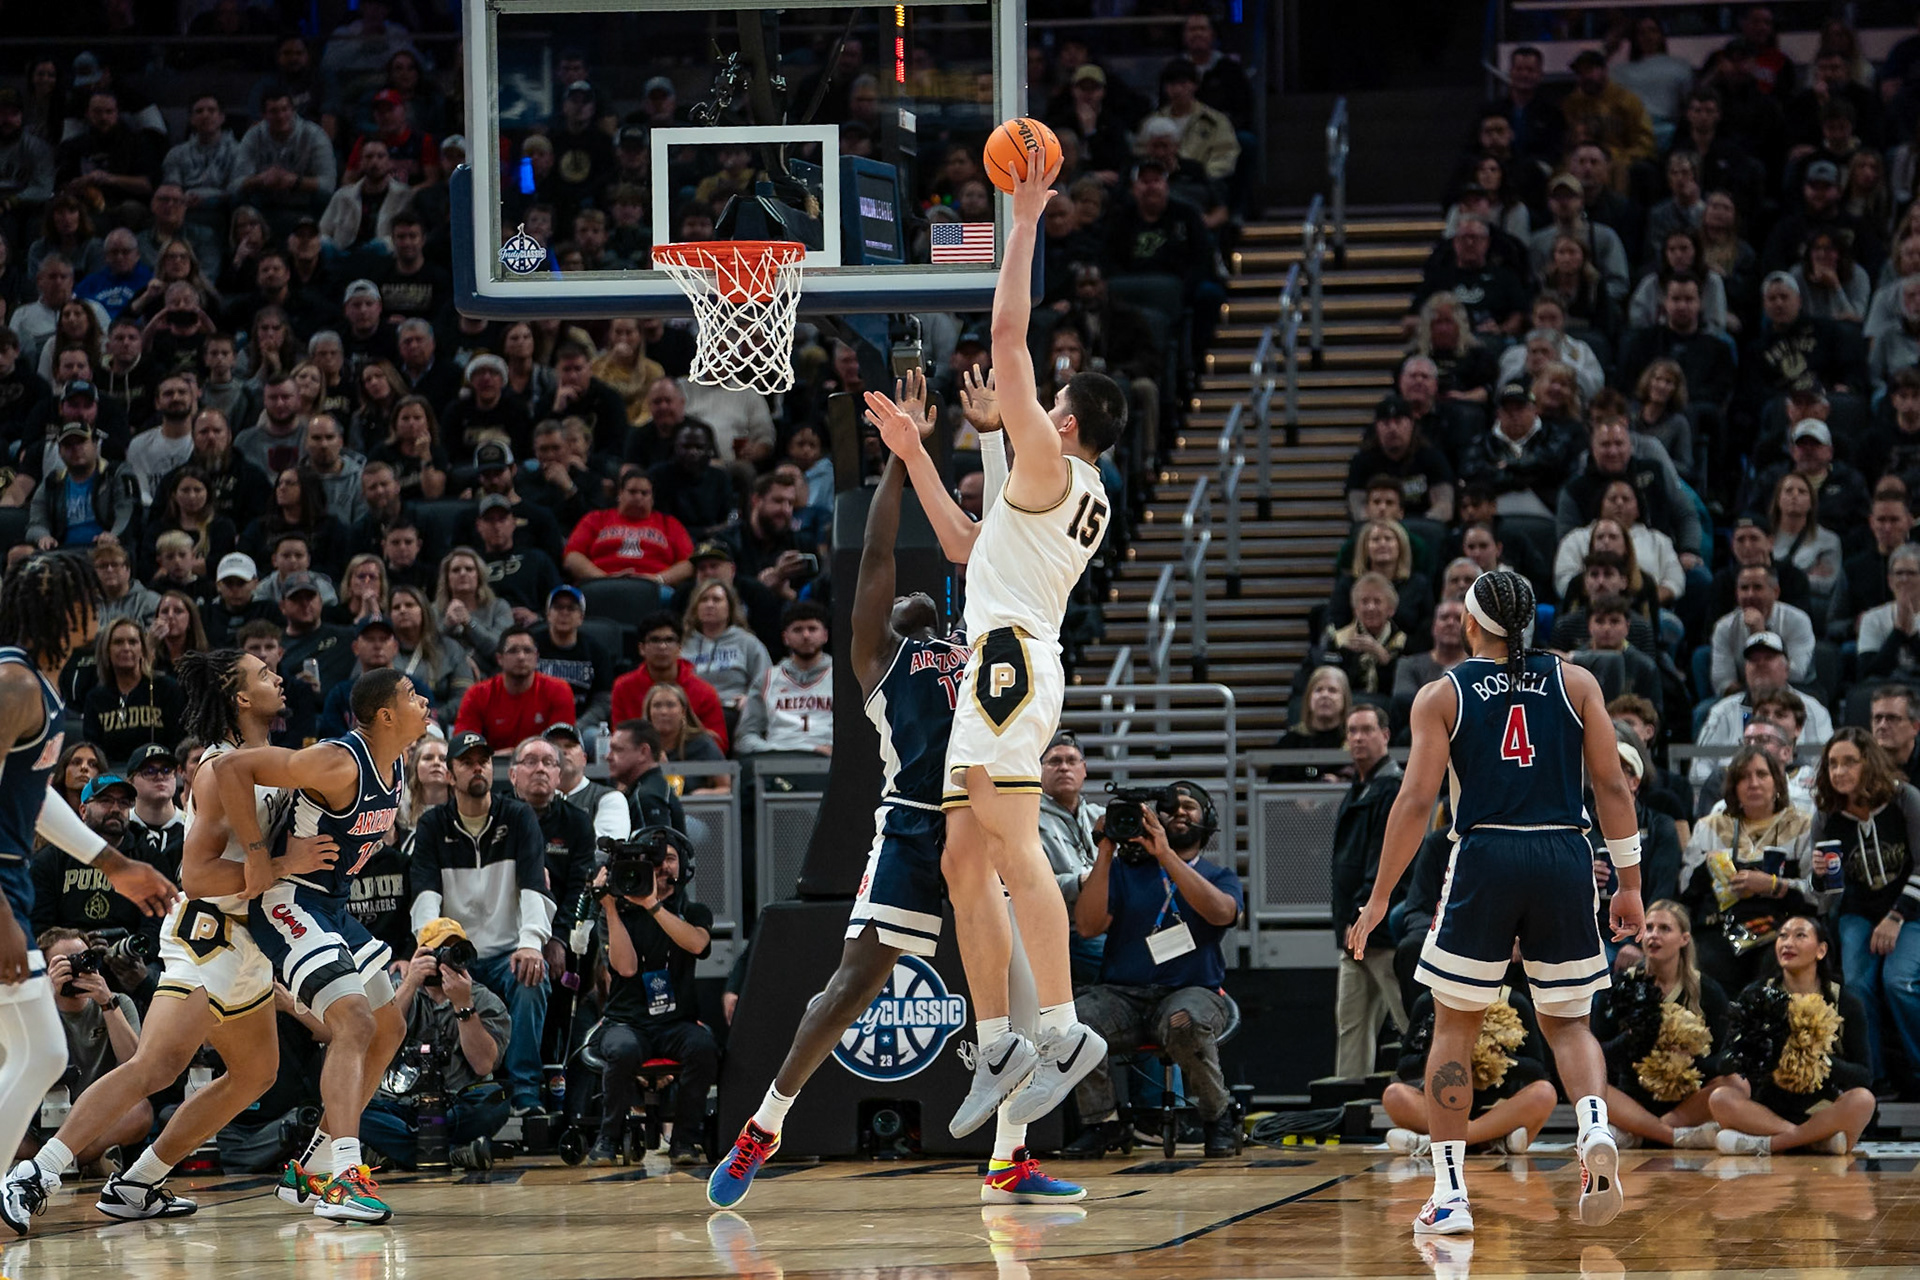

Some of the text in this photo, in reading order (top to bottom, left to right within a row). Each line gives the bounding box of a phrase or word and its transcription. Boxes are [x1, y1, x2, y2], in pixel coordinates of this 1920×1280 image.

[1067, 492, 1107, 548] 15
[801, 715, 809, 732] 1
[1500, 704, 1536, 767] 4
[880, 1055, 893, 1067] 23
